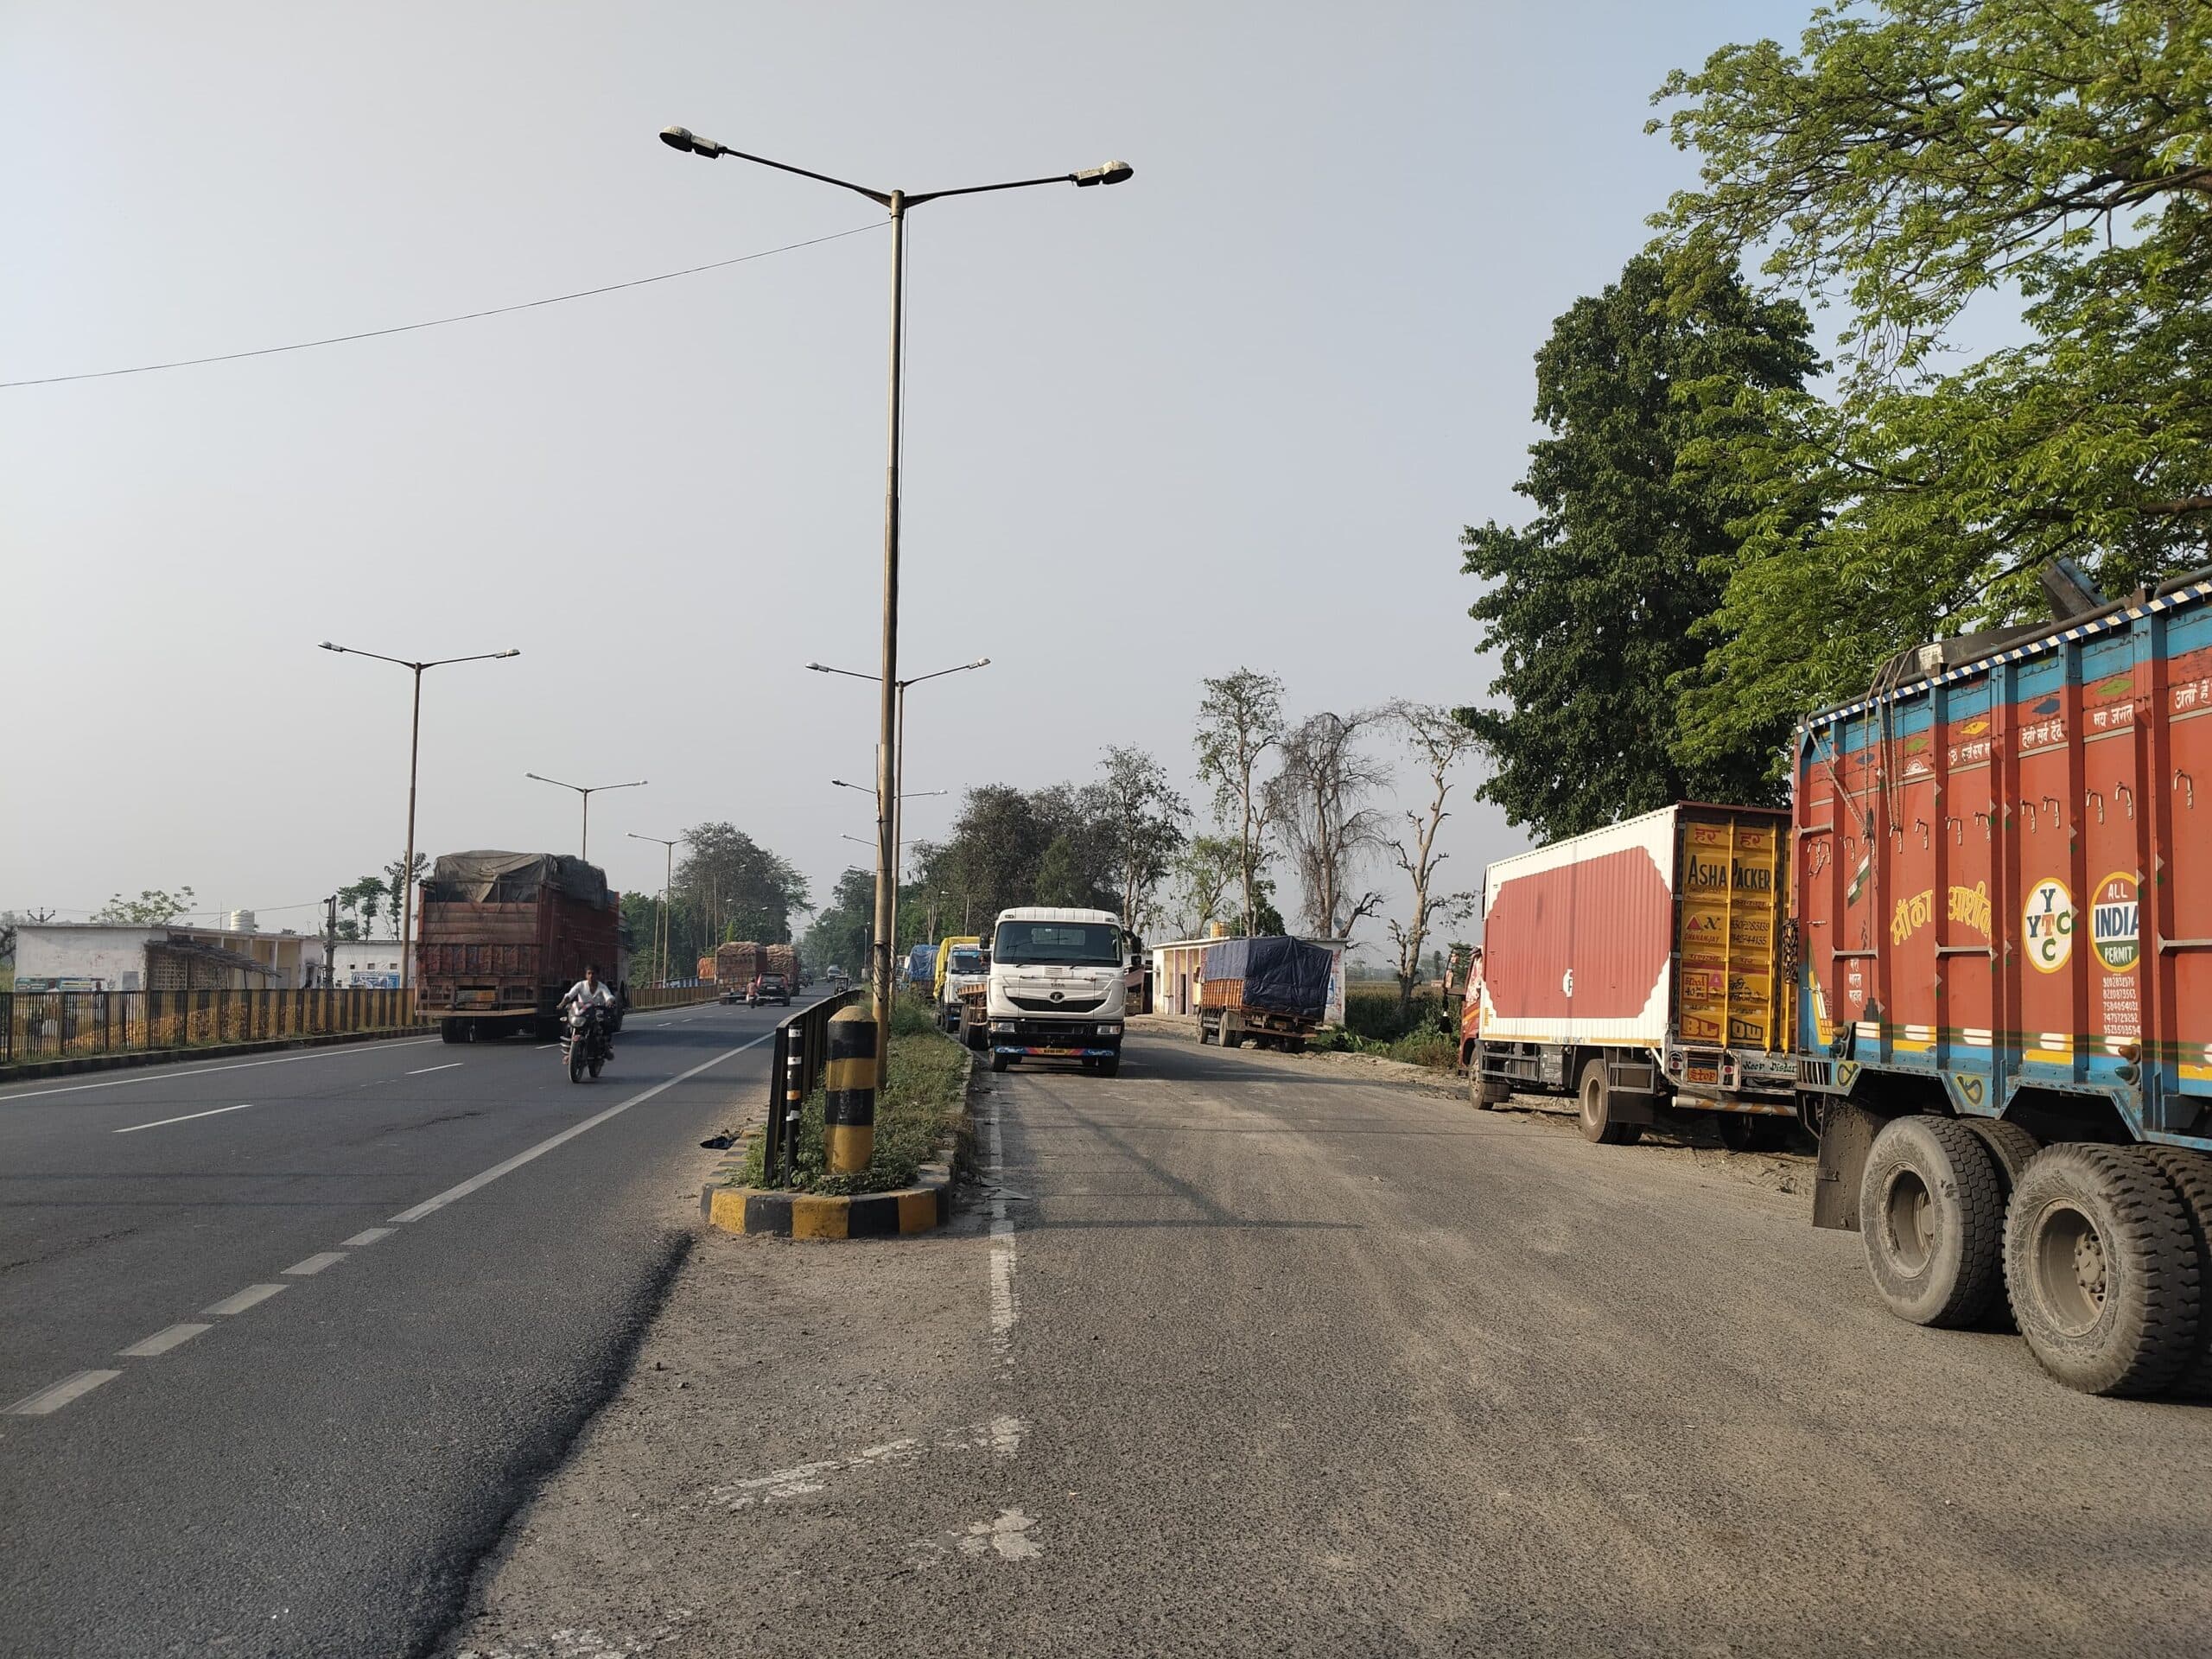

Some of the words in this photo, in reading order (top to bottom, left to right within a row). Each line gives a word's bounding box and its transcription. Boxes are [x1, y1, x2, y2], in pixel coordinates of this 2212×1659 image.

[1688, 855, 1727, 887] ASHA
[2108, 883, 2128, 899] ALL
[1948, 880, 1992, 941] आशीव
[2104, 946, 2134, 964] PERMIT
